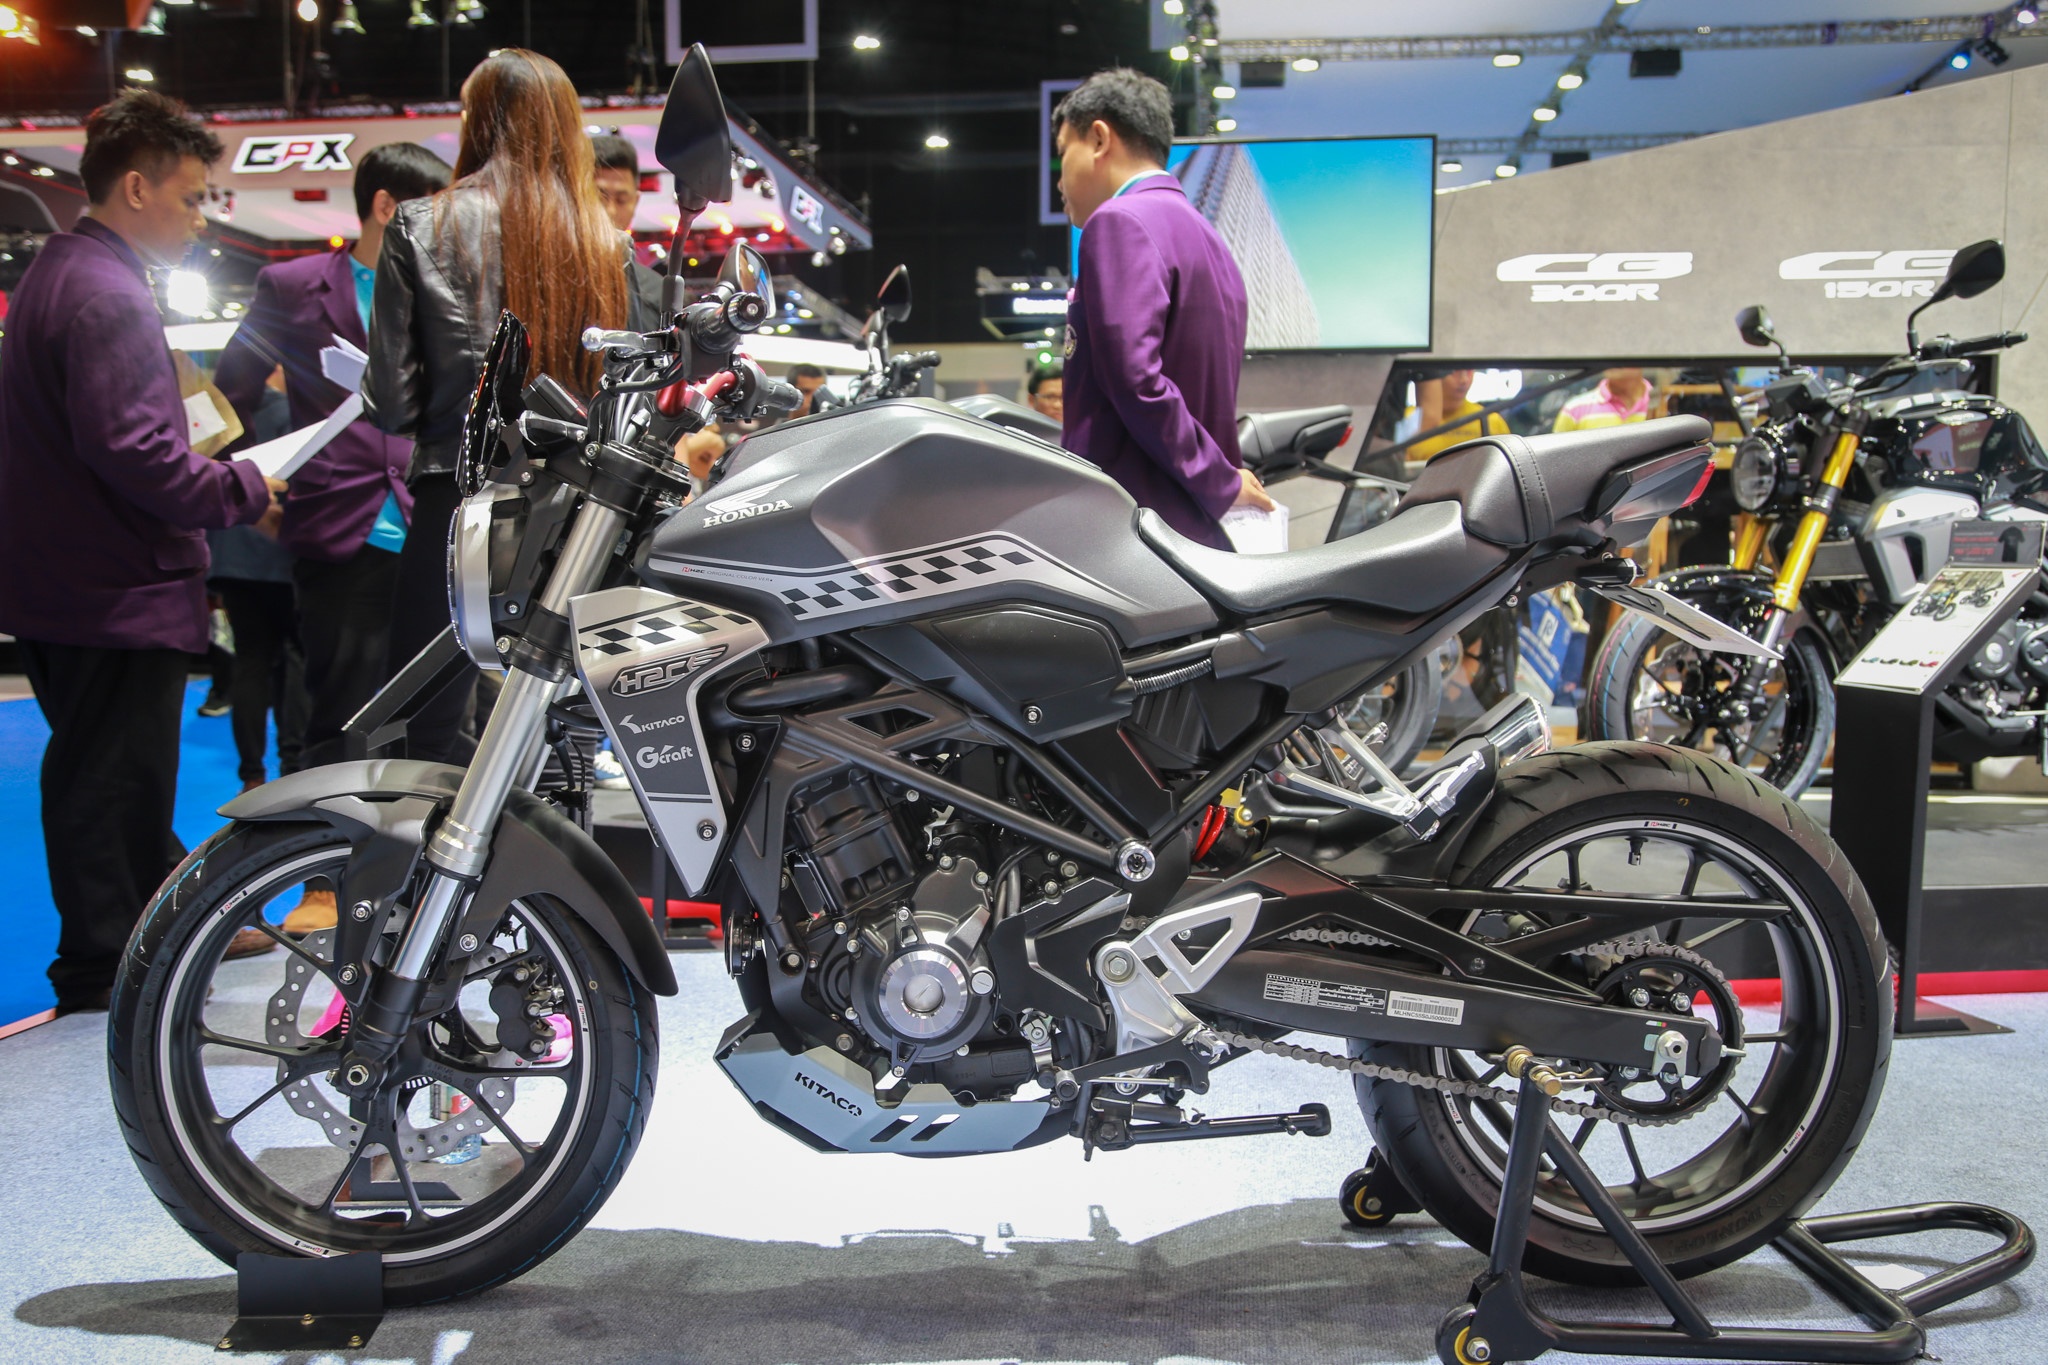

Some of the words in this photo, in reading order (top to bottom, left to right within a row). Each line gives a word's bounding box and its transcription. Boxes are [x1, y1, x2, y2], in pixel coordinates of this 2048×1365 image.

[238, 137, 349, 169] GPX
[1496, 252, 1693, 282] CB
[1531, 283, 1660, 302] 300R
[1824, 280, 1936, 299] 150R
[702, 499, 793, 528] HONDA
[706, 570, 736, 578] ORIGINAL
[641, 715, 686, 733] KITACO
[794, 1072, 863, 1117] KITACO
